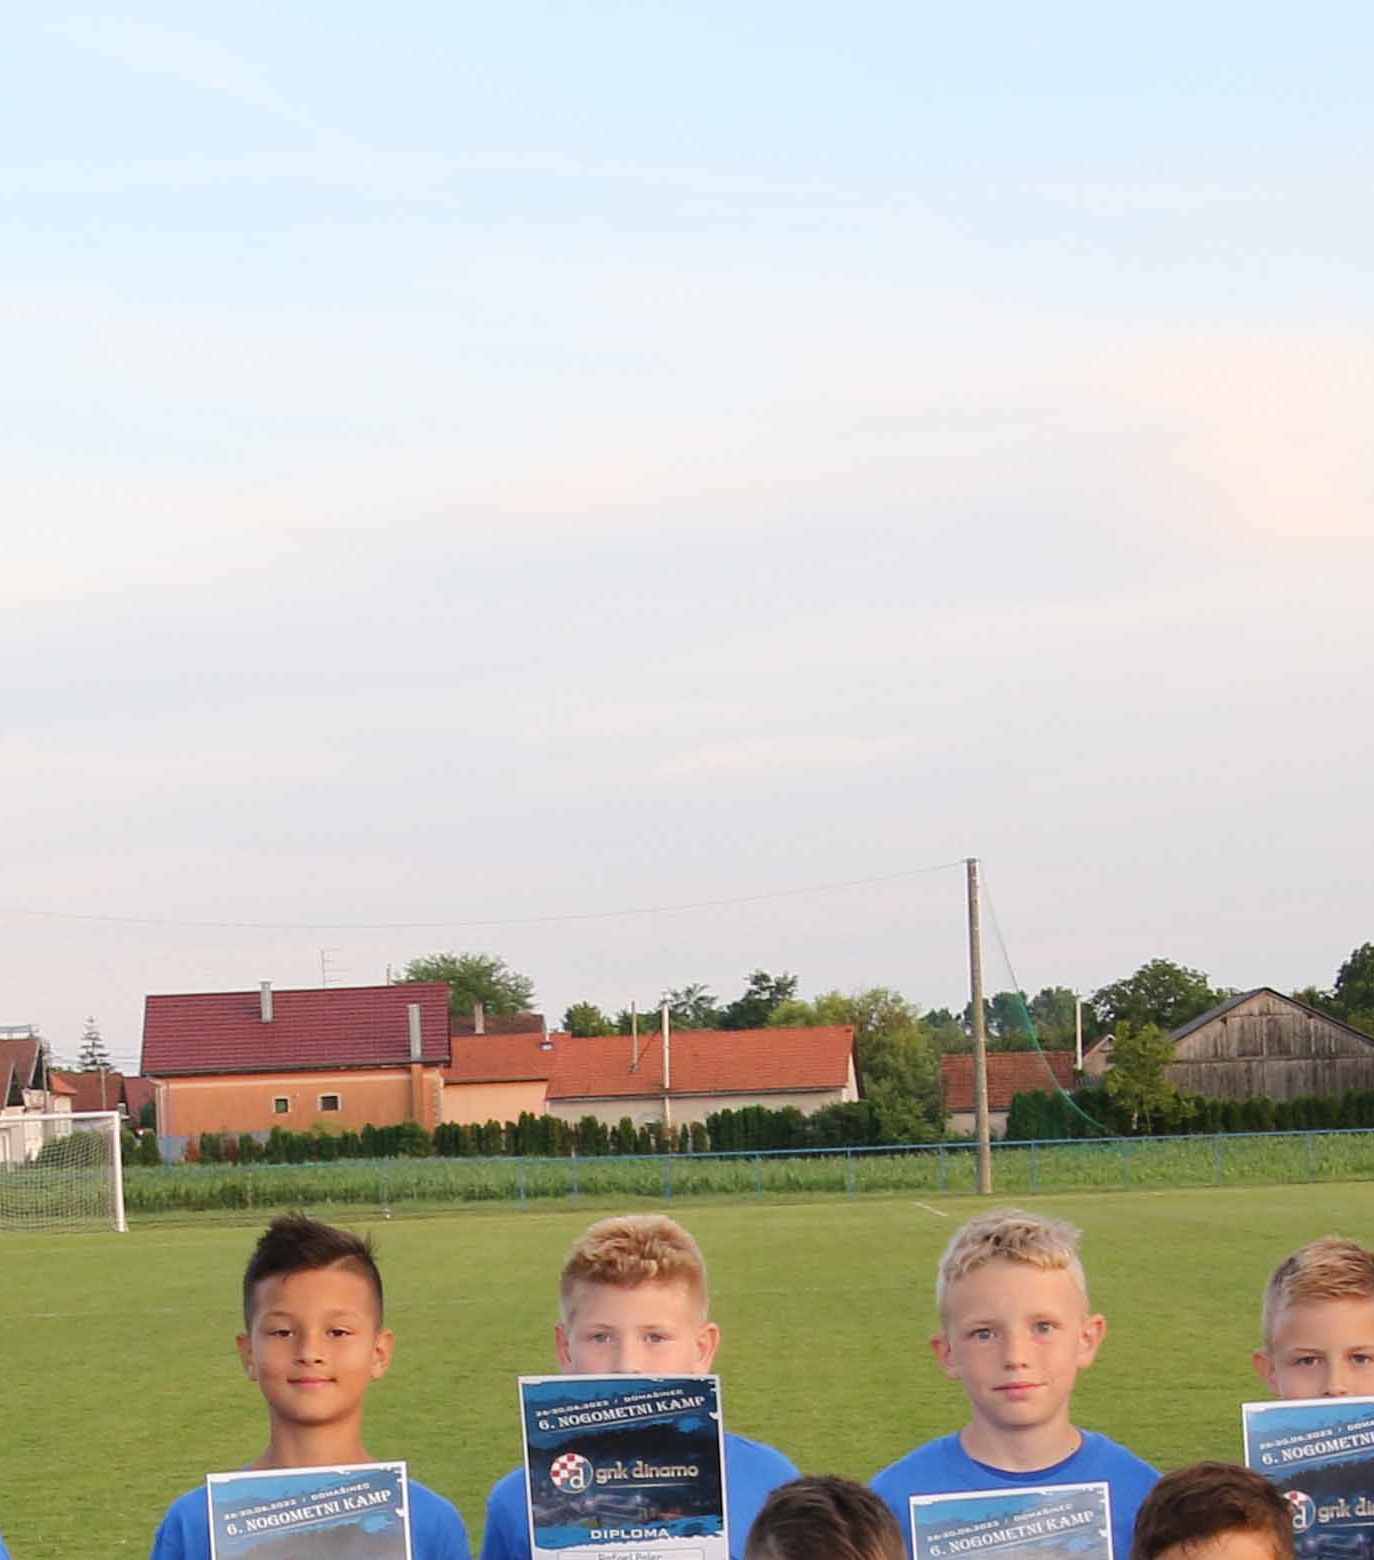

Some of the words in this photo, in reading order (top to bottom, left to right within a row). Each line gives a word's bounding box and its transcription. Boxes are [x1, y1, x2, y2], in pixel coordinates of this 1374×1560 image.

[539, 1420, 556, 1430] 6.
[559, 1403, 653, 1428] NOGOMETNI
[657, 1396, 706, 1411] KAMP
[1262, 1453, 1278, 1465] 6.
[1283, 1432, 1374, 1462] NOGOMETNI
[596, 1462, 627, 1484] gnk
[632, 1461, 699, 1480] dinamo
[227, 1524, 243, 1536] 6.
[247, 1502, 340, 1532] NOGOMETNI
[343, 1490, 392, 1511] KAMP
[1317, 1499, 1350, 1522] gnk
[591, 1528, 669, 1539] DIPLOMA
[930, 1546, 946, 1557] 6.
[950, 1520, 1045, 1554] NOGOMETNI
[1046, 1510, 1094, 1532] KAMP
